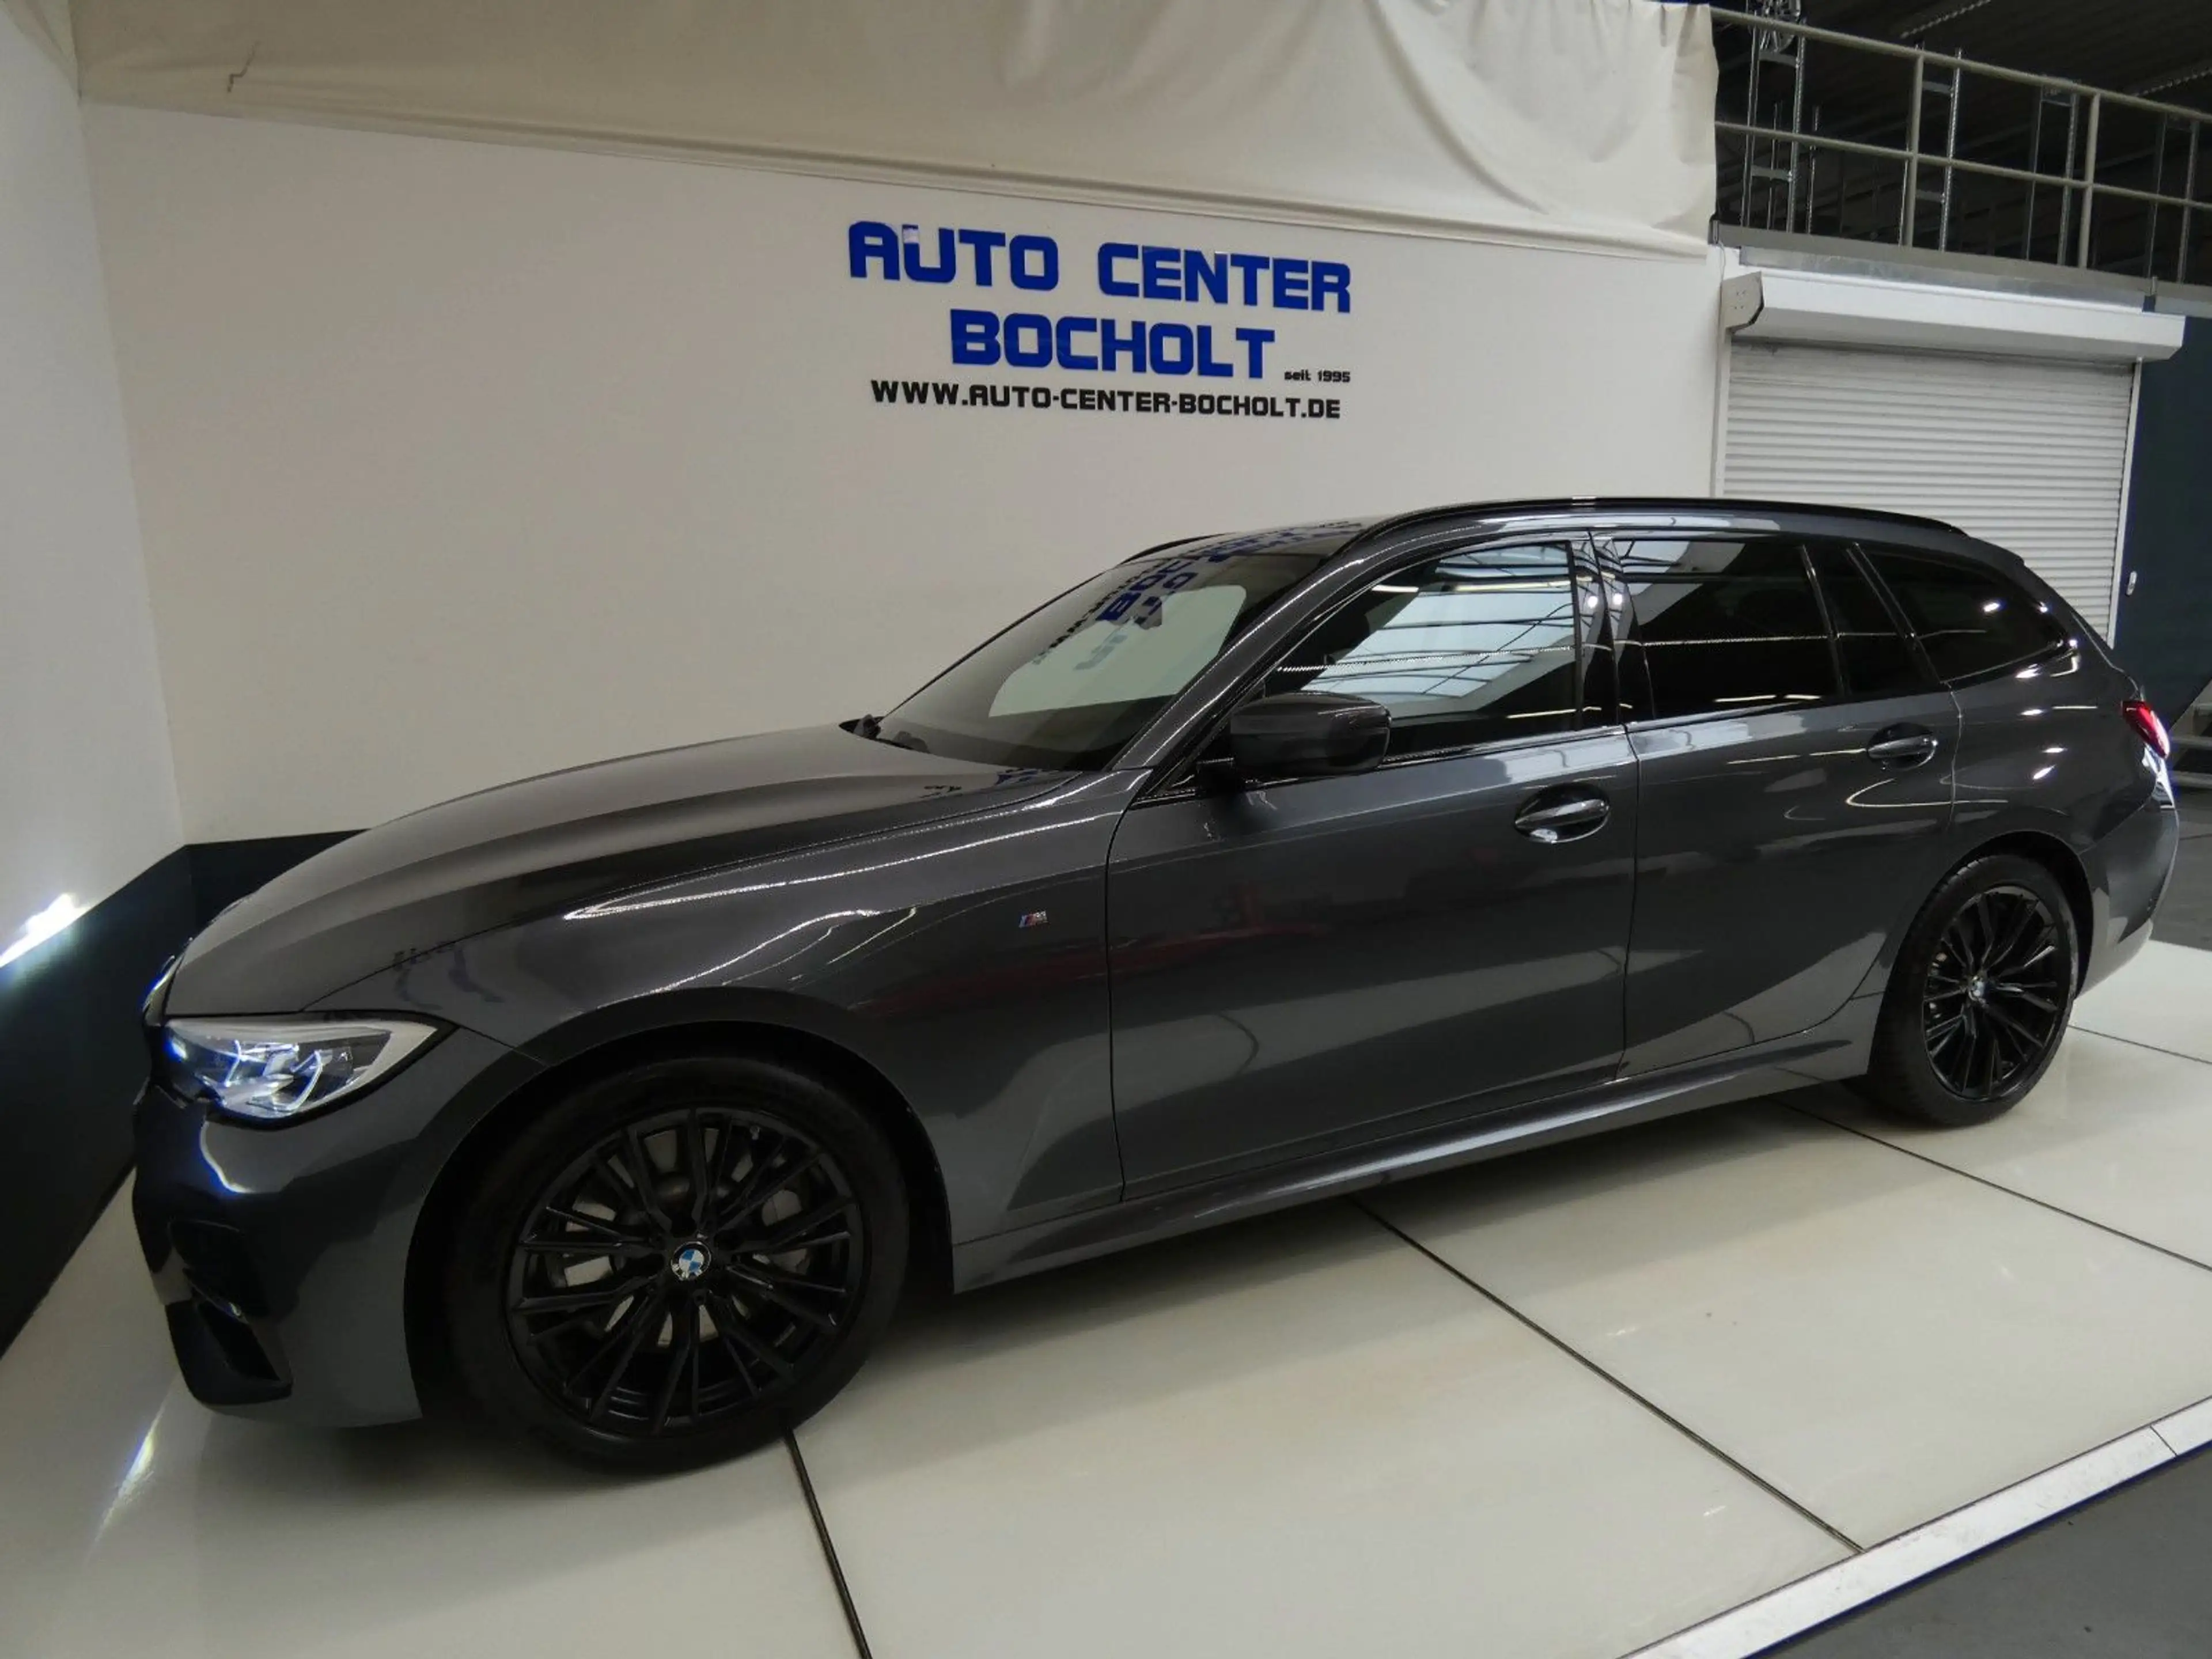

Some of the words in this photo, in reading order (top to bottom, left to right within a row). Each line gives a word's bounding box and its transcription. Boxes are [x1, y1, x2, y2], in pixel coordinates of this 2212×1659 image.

[849, 221, 1058, 290] AUTO
[1098, 243, 1350, 313] CENTER
[950, 309, 1275, 378] BOCHOLT
[871, 380, 1340, 419] WWW.AUTO-CENTER-BOCHOLT.DE
[1284, 369, 1312, 381] seit
[1317, 370, 1351, 382] 1995
